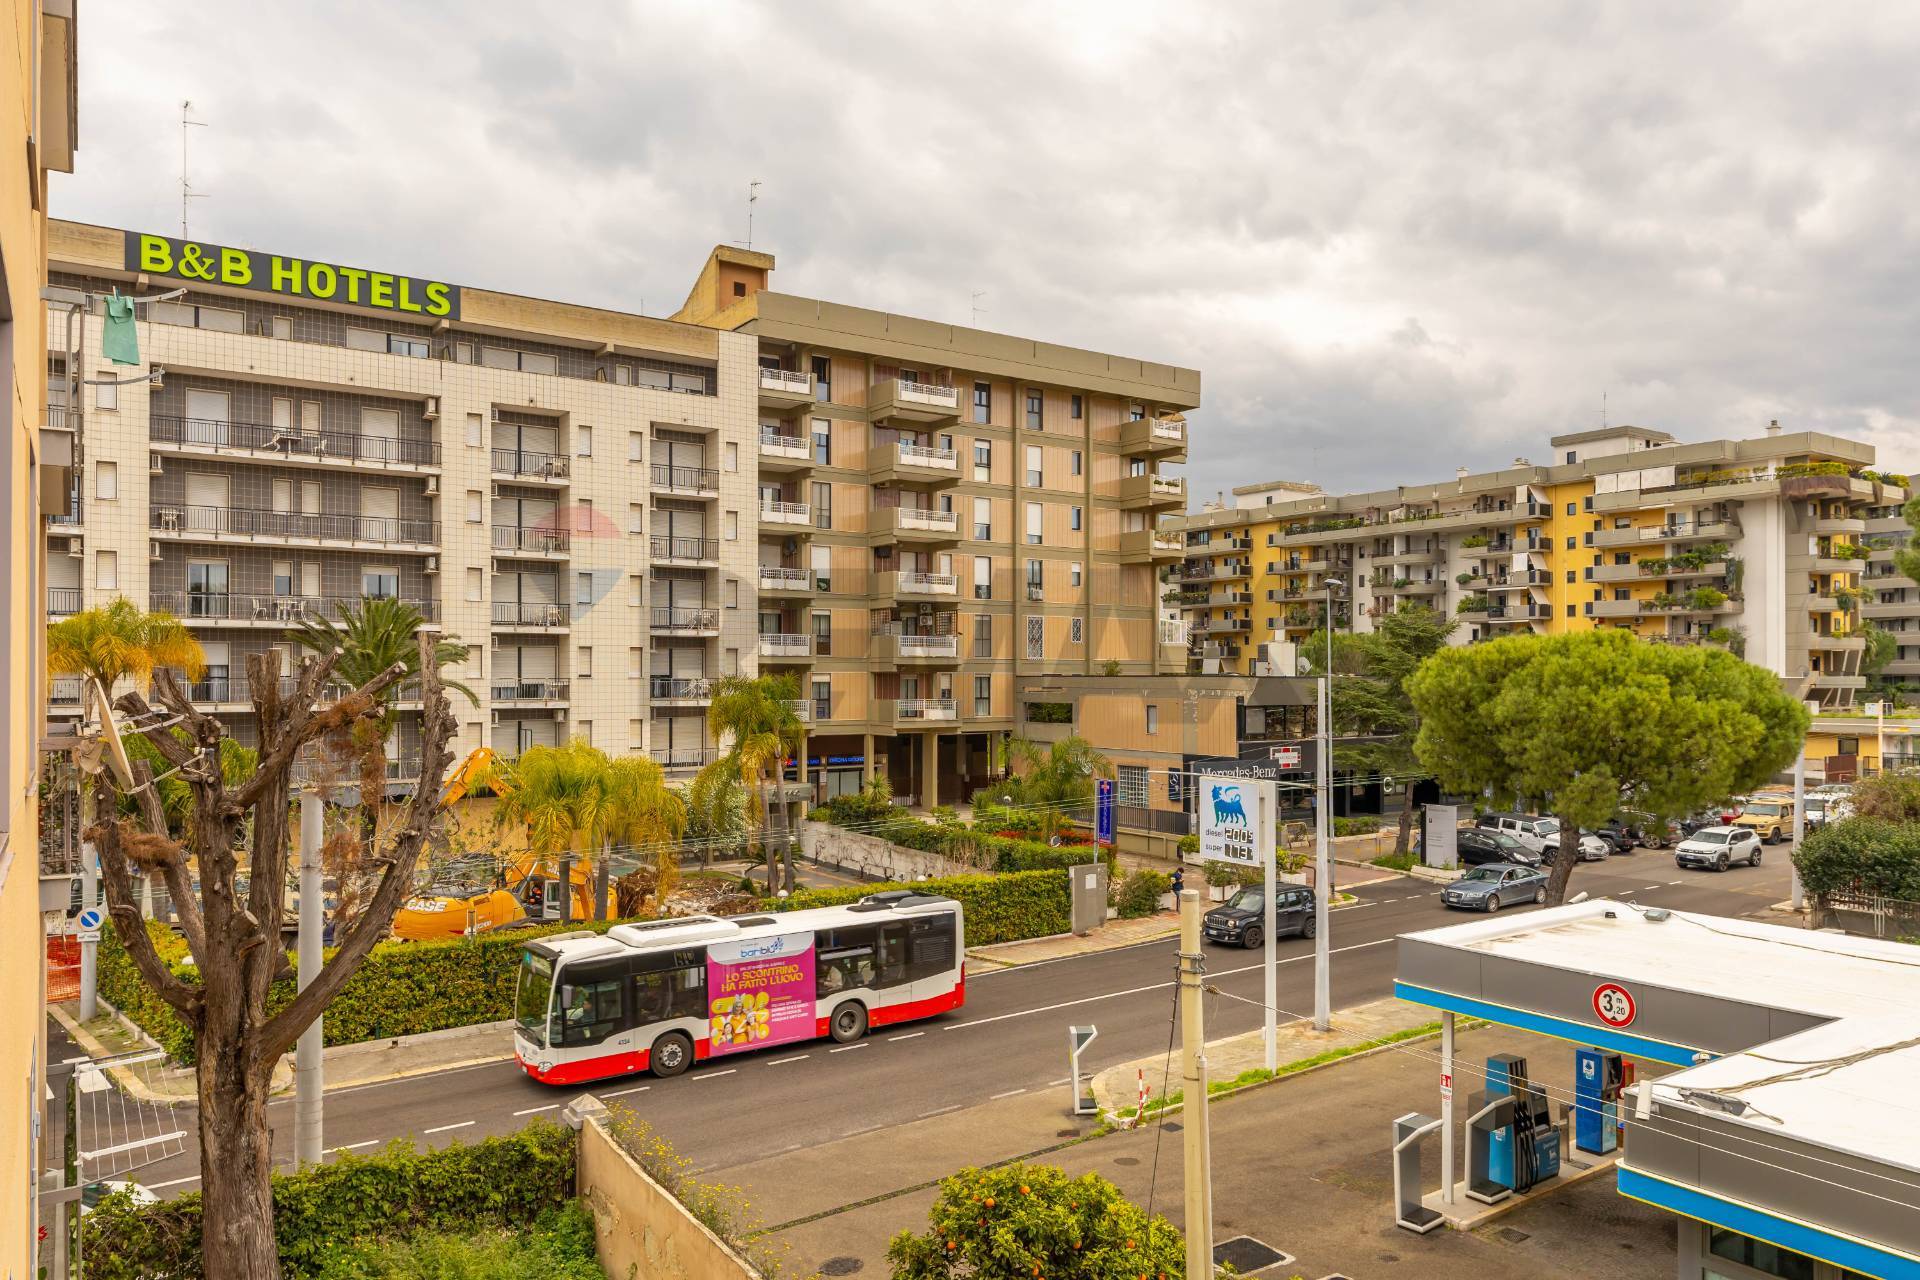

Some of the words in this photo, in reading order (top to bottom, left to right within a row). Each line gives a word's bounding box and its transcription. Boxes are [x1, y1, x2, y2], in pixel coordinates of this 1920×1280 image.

[140, 234, 253, 285] B&B
[271, 256, 451, 316] HOTELS
[1205, 828, 1223, 837] diesel
[1205, 843, 1223, 852] super
[406, 899, 448, 912] CASE
[726, 973, 739, 982] LO
[742, 964, 798, 979] SCONTRINO
[721, 983, 736, 992] HA
[738, 978, 768, 990] FATTO
